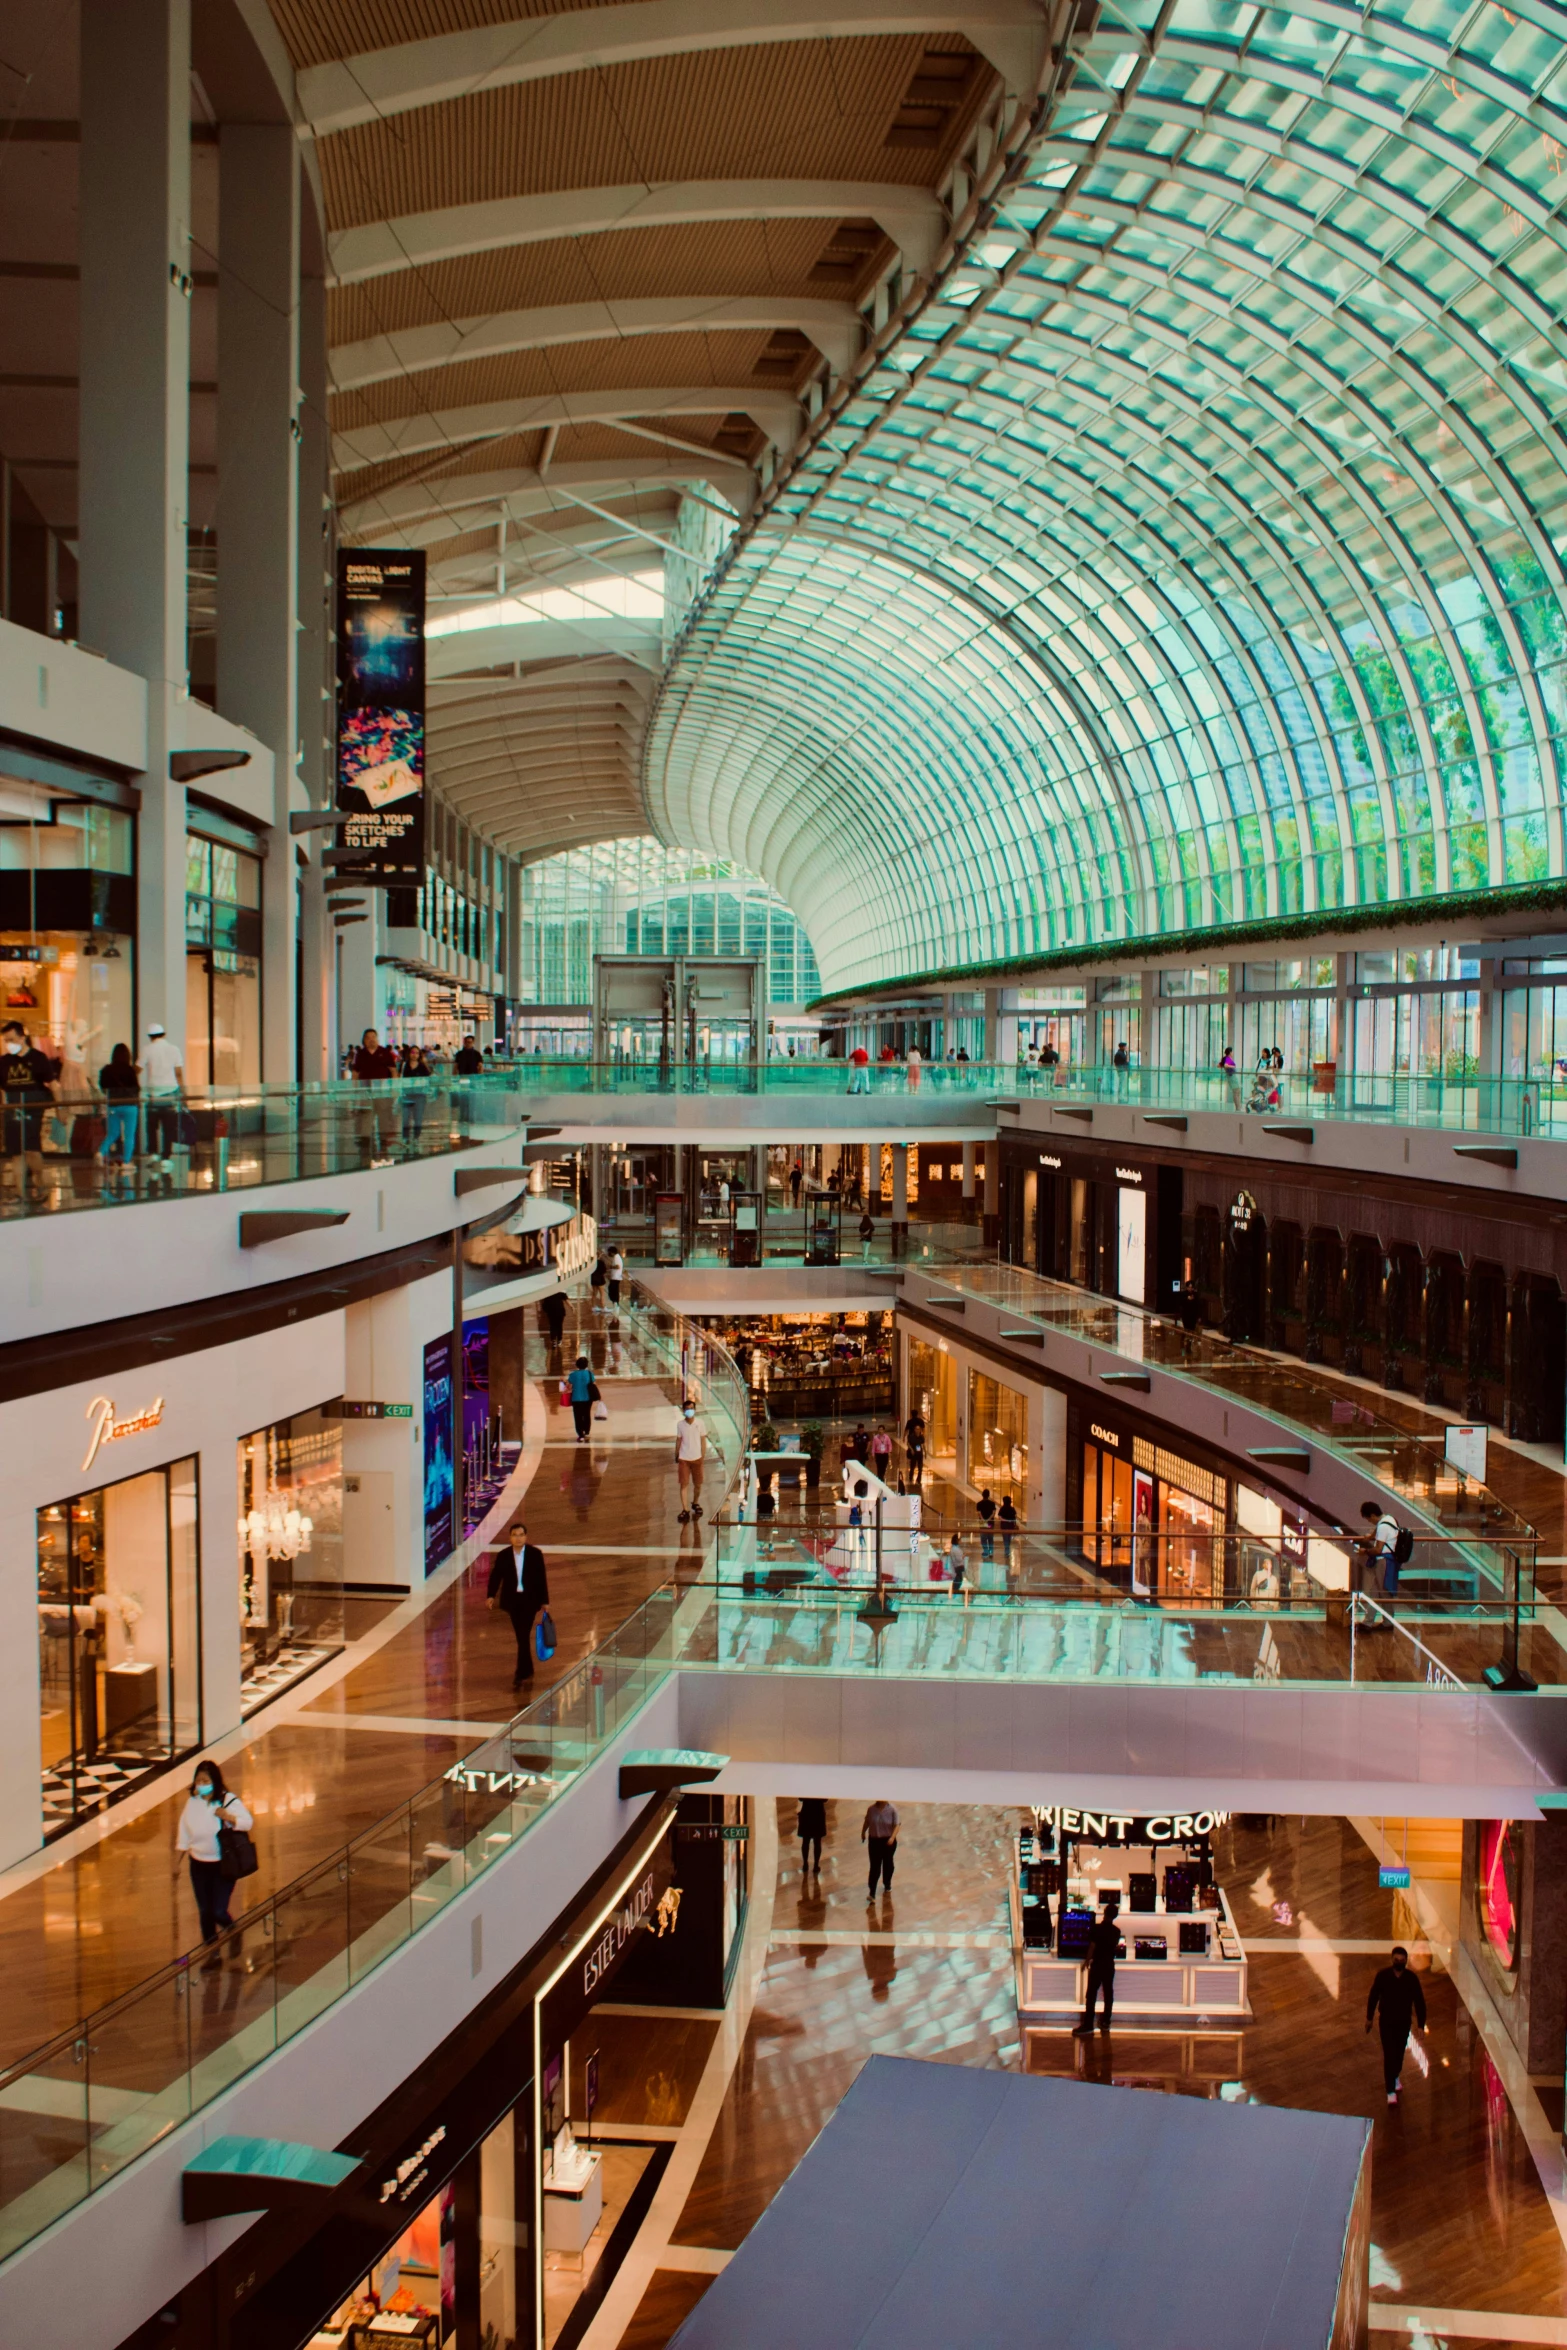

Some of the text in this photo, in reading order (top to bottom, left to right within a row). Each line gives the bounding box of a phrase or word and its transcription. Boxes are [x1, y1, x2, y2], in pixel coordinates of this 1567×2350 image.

[346, 565, 382, 575] DIGITAL
[346, 574, 384, 584] CANVAS
[383, 814, 414, 825] YOUR
[345, 825, 405, 836] SKETCHES
[345, 835, 388, 847] TO LIFE
[393, 1406, 411, 1416] EXIT
[1091, 1423, 1119, 1447] COACH
[730, 1828, 747, 1838] EXIT
[1387, 1875, 1406, 1886] EXIT
[617, 1872, 654, 1950] LAUDER
